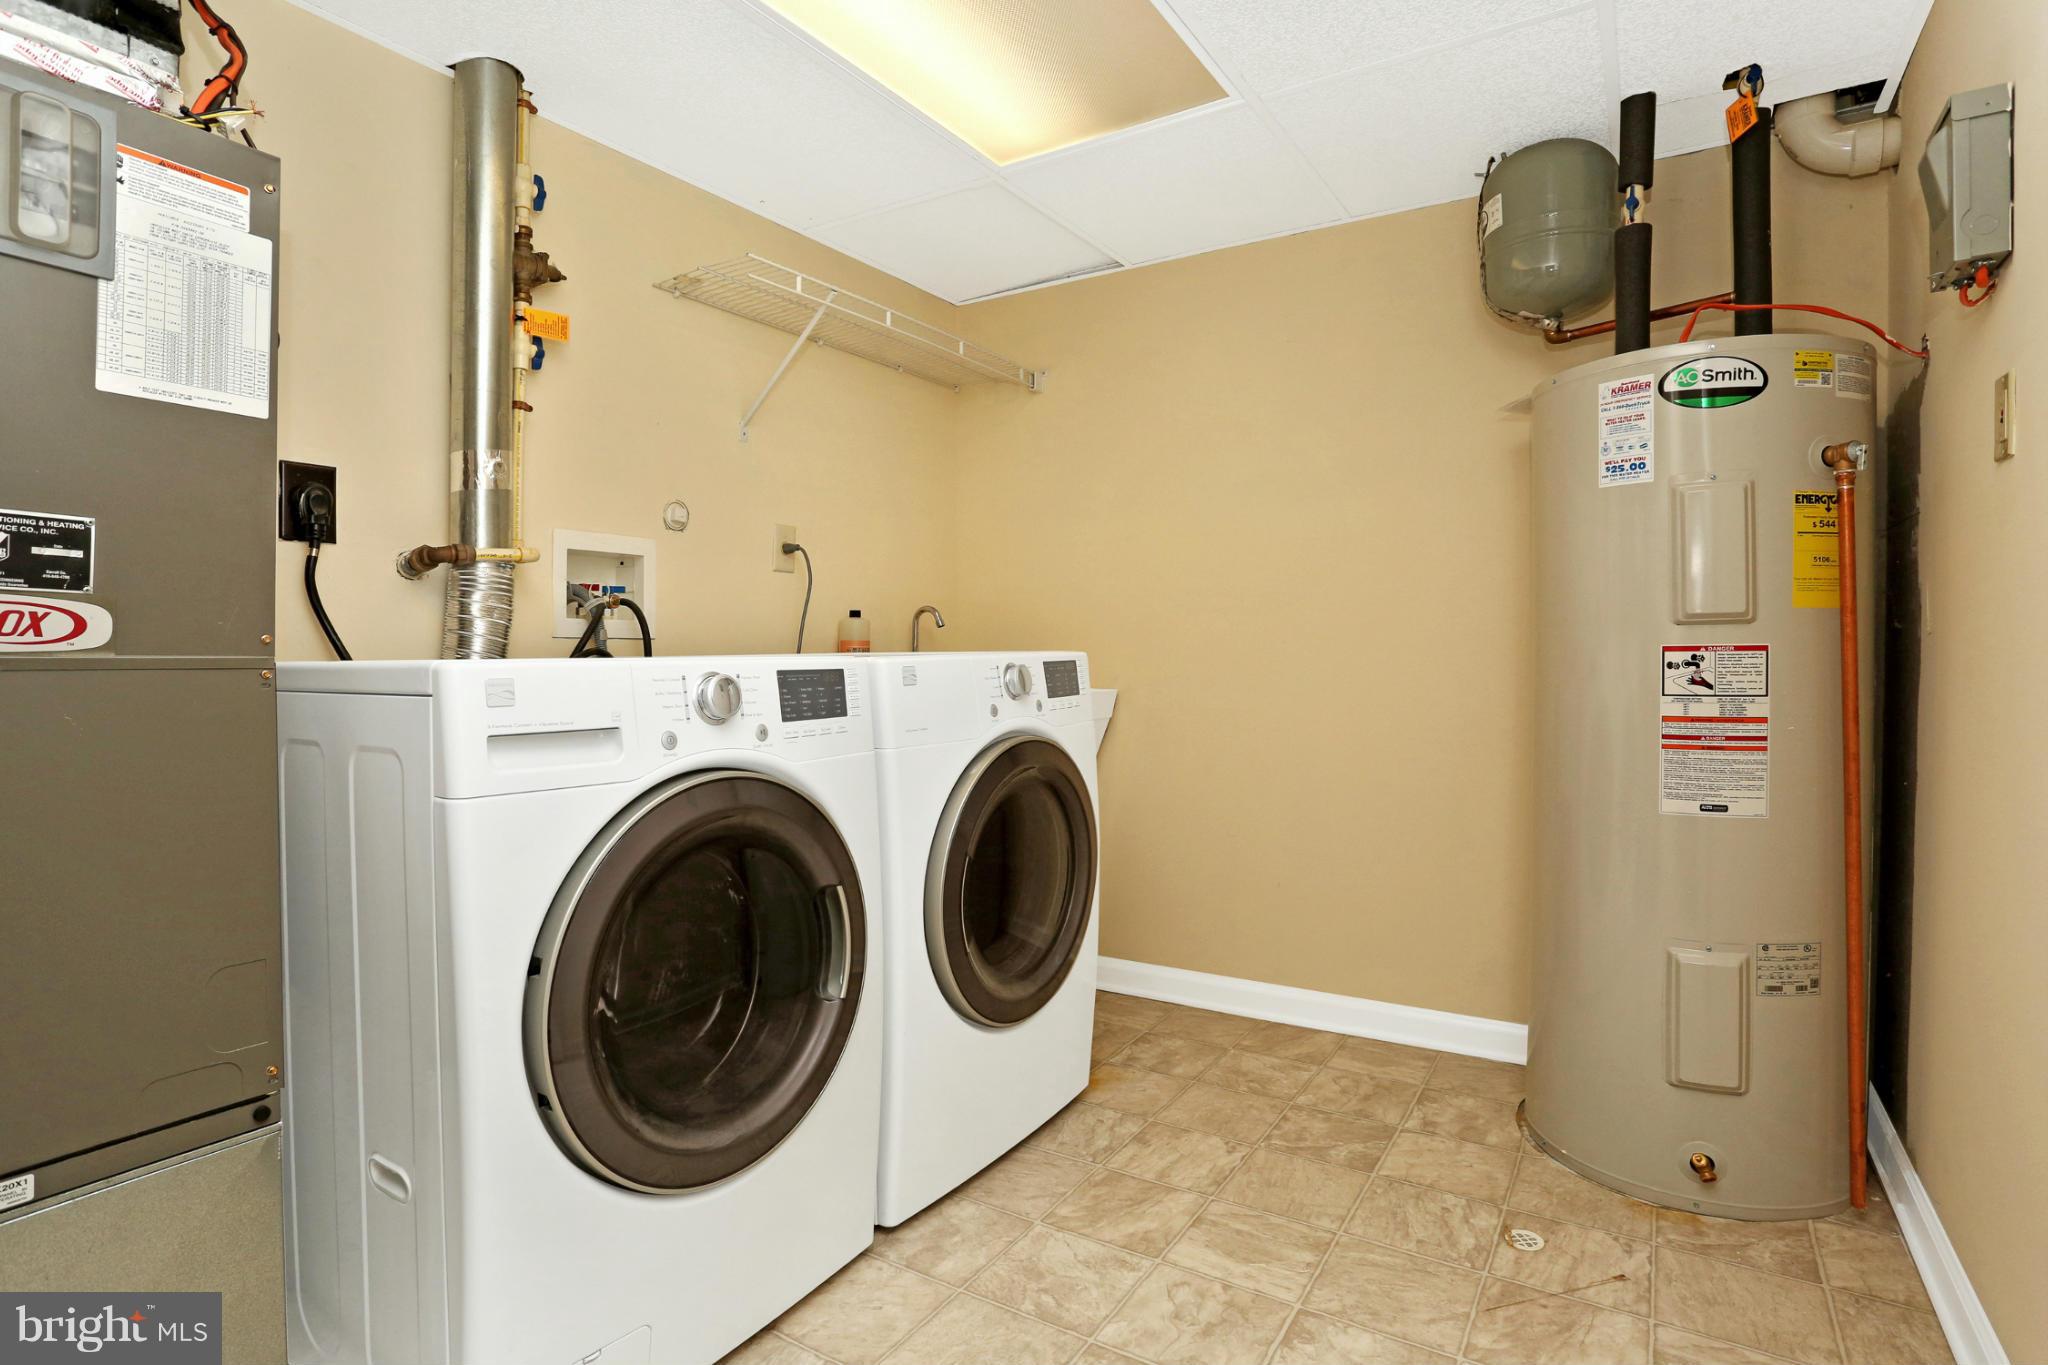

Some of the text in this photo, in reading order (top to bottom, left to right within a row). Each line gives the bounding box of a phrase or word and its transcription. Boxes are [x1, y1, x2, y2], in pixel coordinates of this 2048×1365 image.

[166, 161, 202, 179] WARNING
[1611, 380, 1652, 396] KRAMER
[1605, 461, 1647, 473] $25.00
[46, 520, 85, 530] HEATING
[1819, 519, 1836, 528] 544
[40, 527, 59, 536] INC.
[0, 1177, 29, 1193] 20X1
